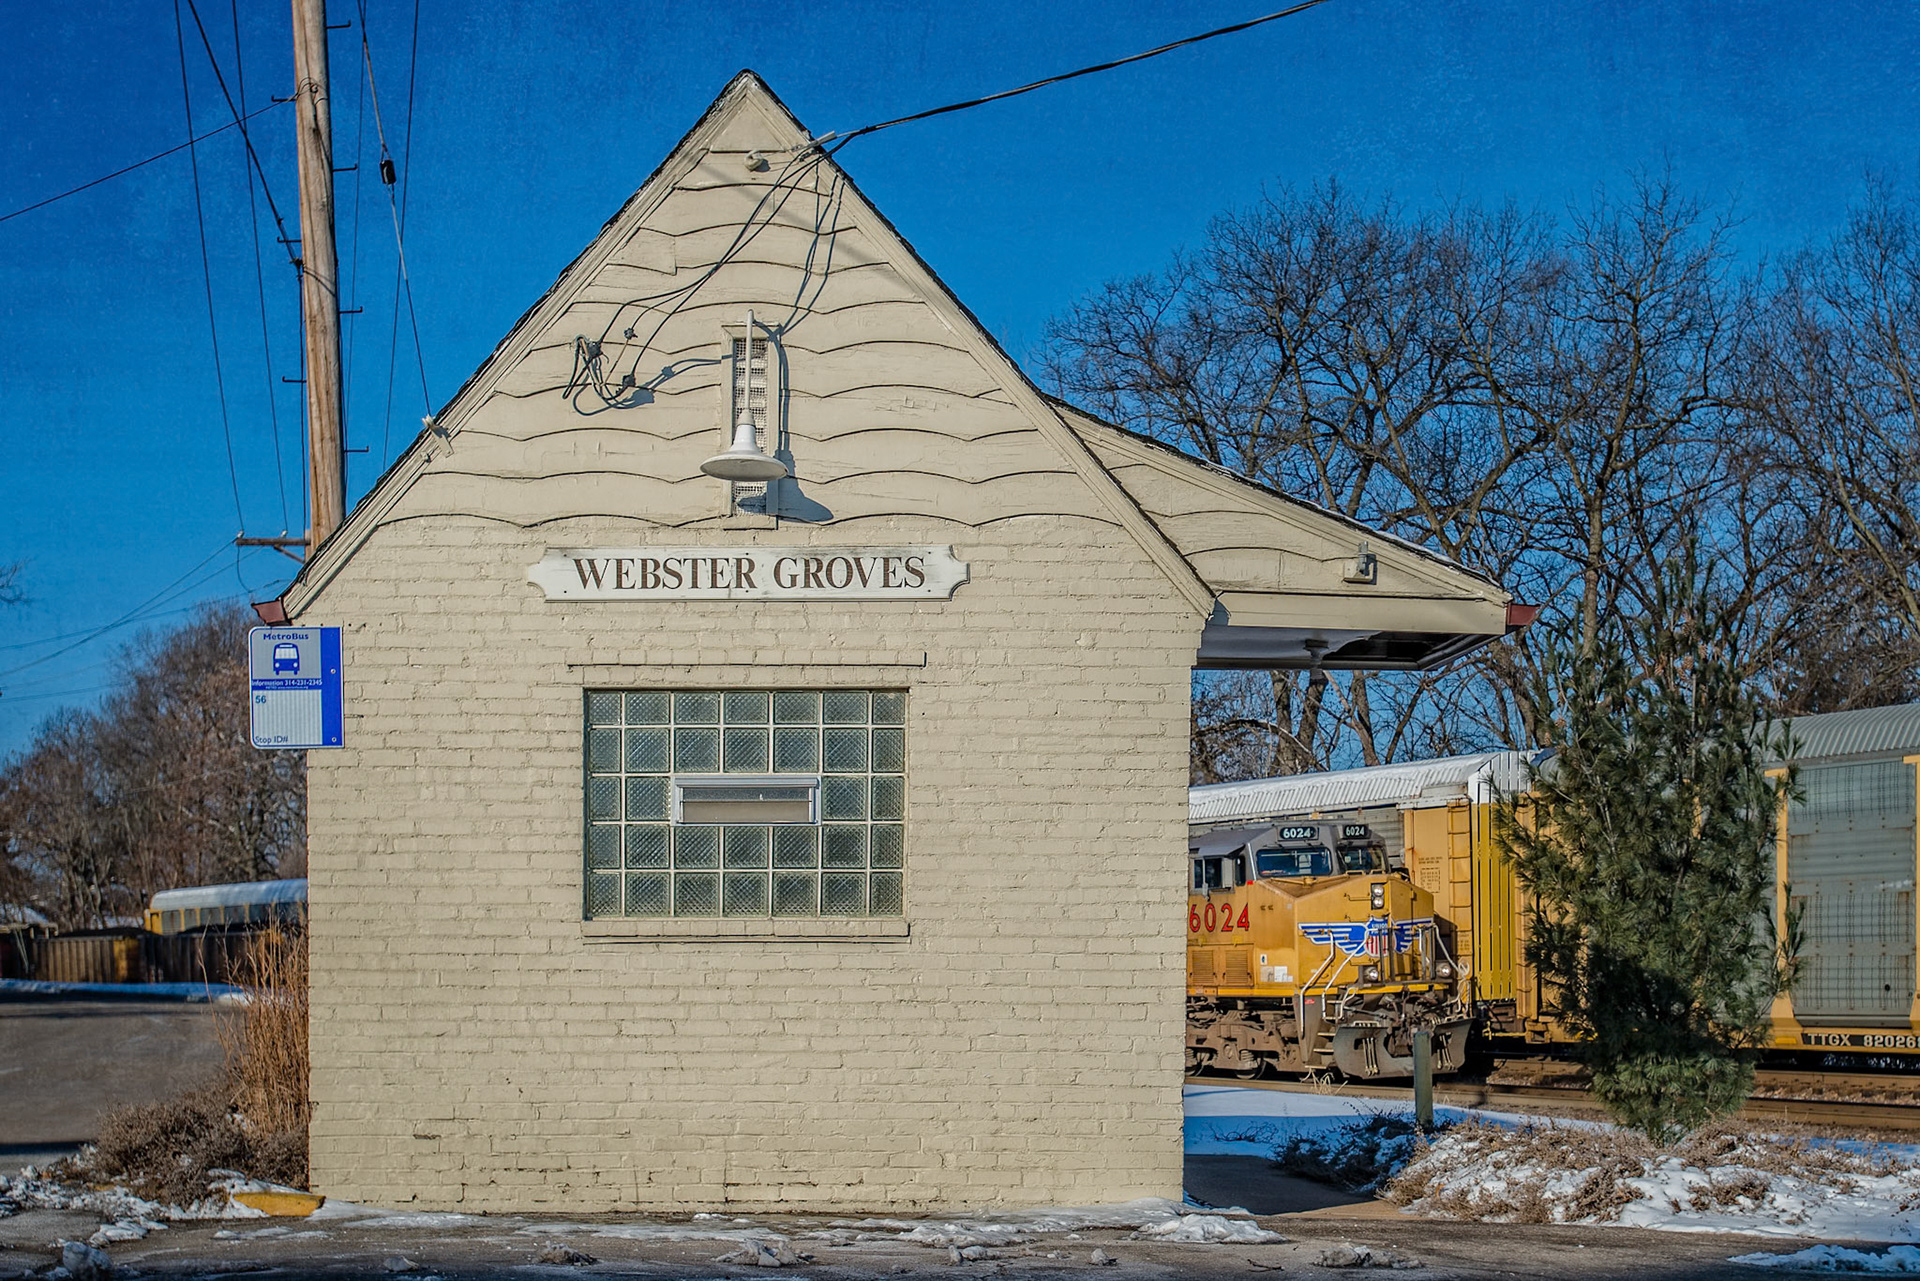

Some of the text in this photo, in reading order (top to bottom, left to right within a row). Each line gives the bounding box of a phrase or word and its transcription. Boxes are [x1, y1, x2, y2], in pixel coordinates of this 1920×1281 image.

[572, 556, 926, 590] WEBSTER GROVES
[255, 695, 266, 704] 56
[255, 736, 272, 744] Stop
[1282, 828, 1311, 838] 6024
[1345, 826, 1365, 836] 6024
[1189, 903, 1250, 932] 6024
[1807, 1033, 1851, 1046] TTGX
